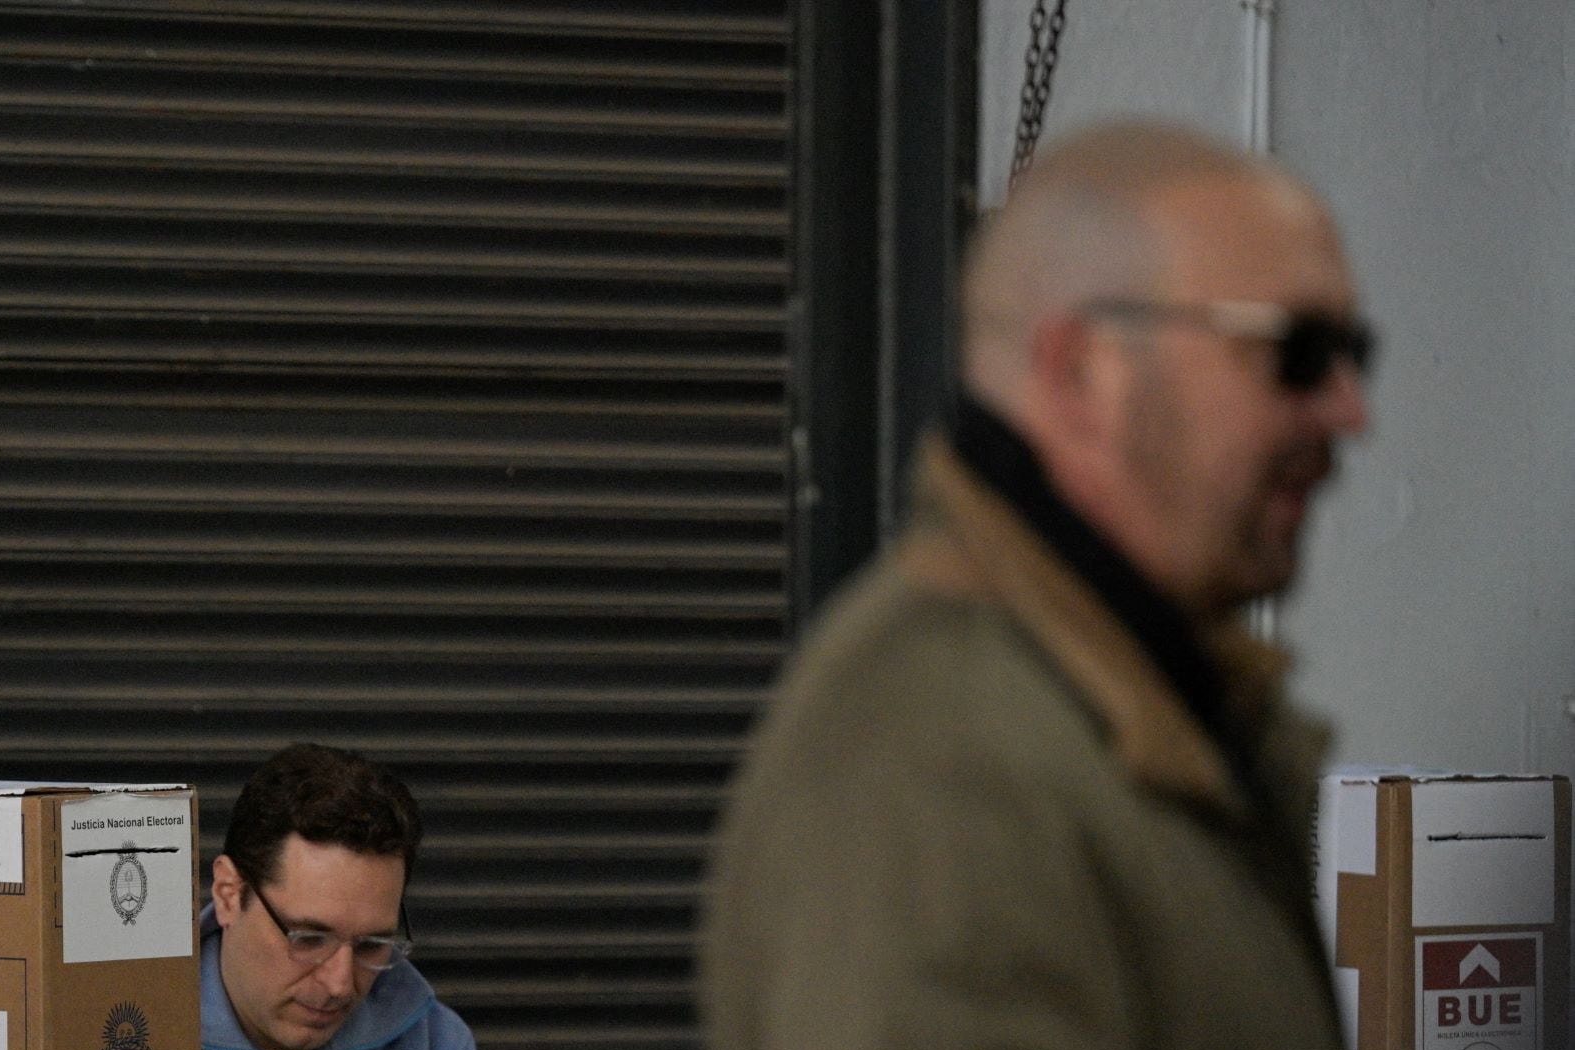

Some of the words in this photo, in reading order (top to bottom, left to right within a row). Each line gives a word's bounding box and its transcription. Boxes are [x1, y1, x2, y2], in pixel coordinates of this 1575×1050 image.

[71, 820, 105, 831] Justicia
[106, 817, 145, 829] Nacional
[146, 815, 184, 827] Electoral
[1438, 993, 1522, 1027] BUE
